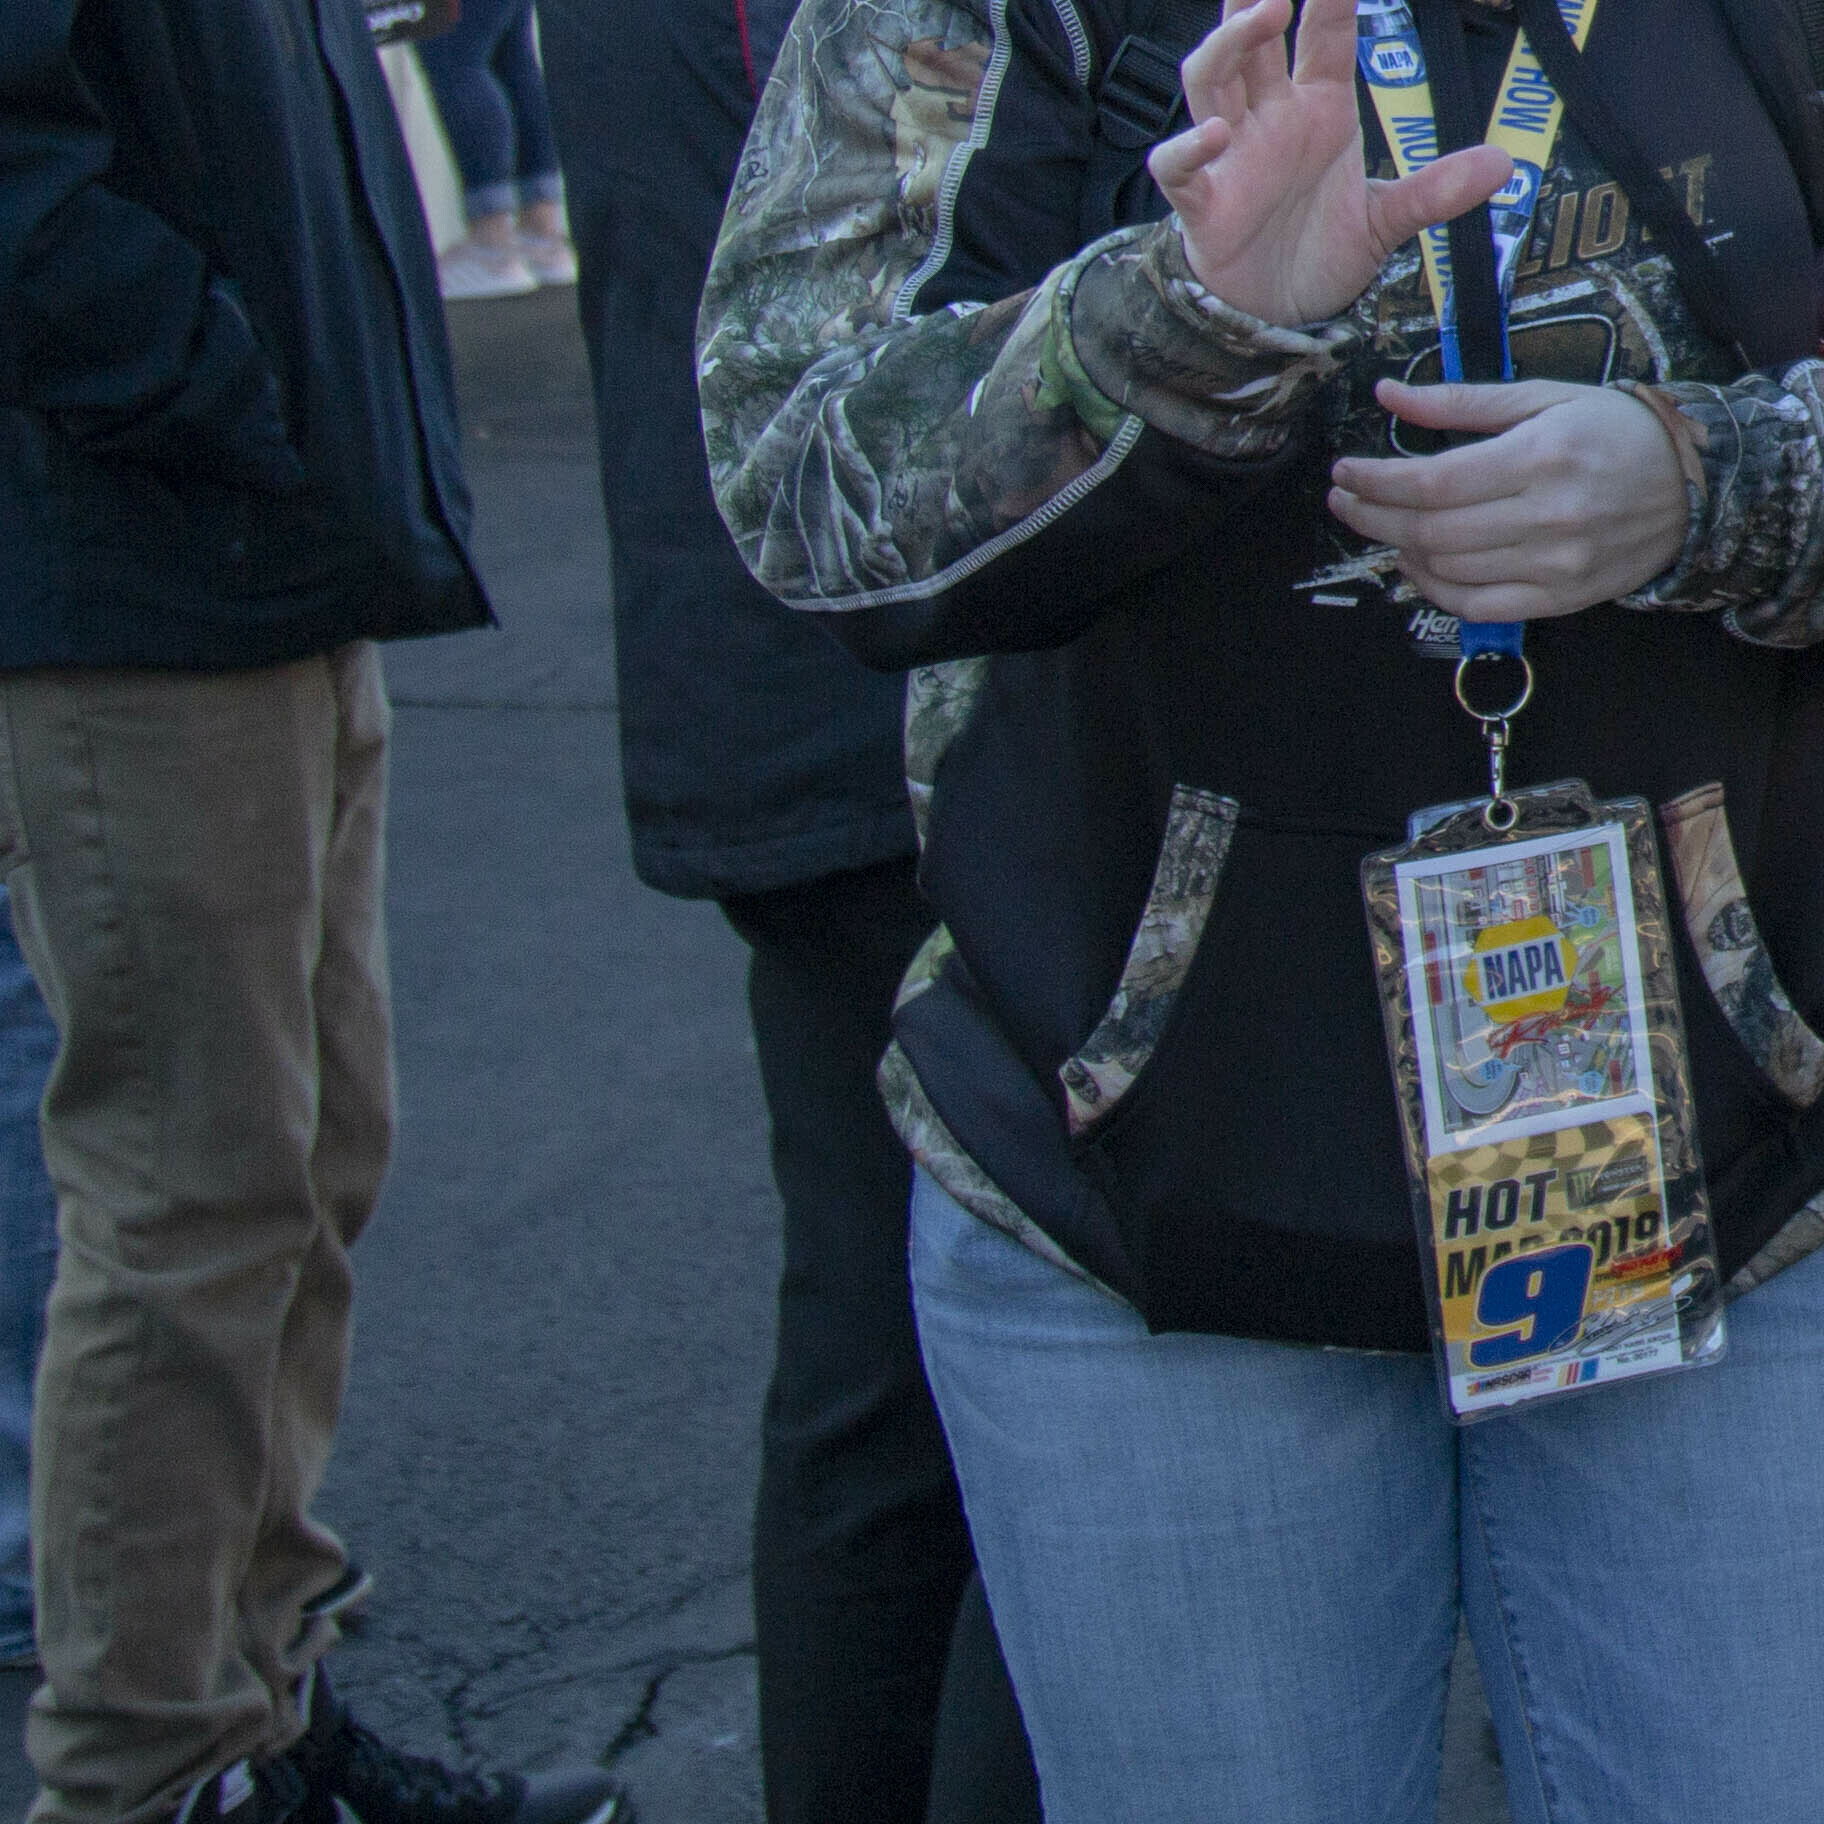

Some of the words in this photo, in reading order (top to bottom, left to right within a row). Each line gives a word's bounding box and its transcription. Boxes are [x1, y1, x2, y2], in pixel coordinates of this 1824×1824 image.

[1377, 50, 1414, 71] NAPA
[1482, 940, 1566, 1001] NAPA
[1443, 1169, 1559, 1241] HOT
[1468, 1241, 1595, 1369] 9
